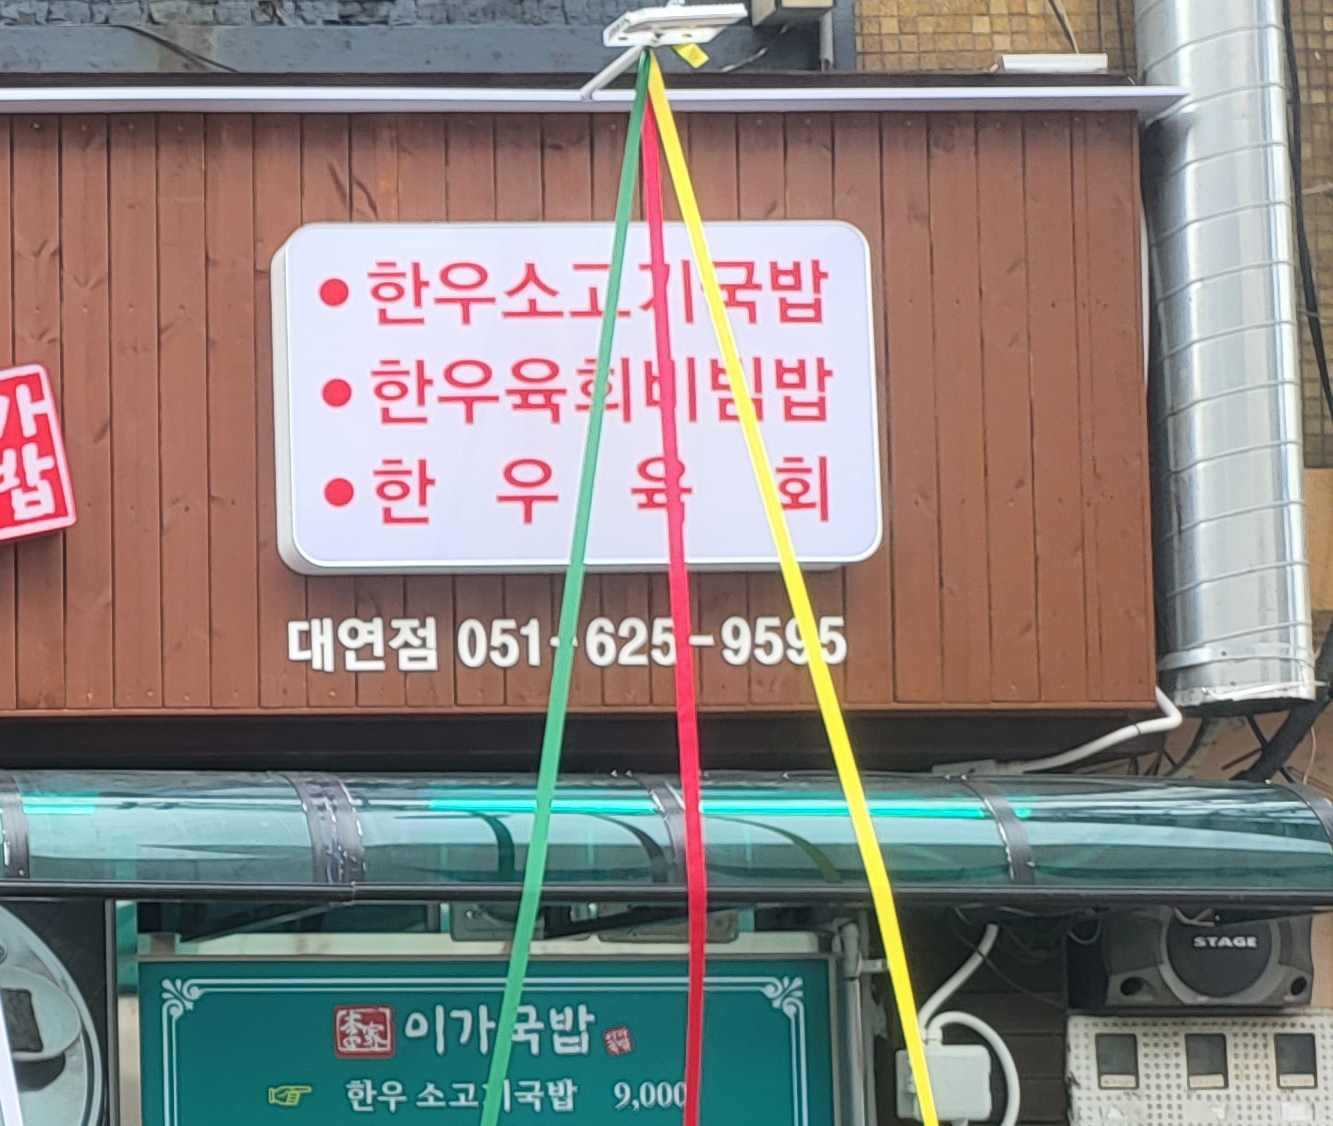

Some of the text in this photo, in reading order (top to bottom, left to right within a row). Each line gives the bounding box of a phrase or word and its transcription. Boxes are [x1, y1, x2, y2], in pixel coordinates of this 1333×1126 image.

[367, 256, 830, 327] 한우소고기국밥
[369, 355, 834, 425] 한우육회비빔밥
[286, 615, 849, 673] 대연점 051-625-9595
[1193, 935, 1258, 948] STAGE
[404, 1003, 596, 1056] 이가국밥
[345, 1078, 408, 1113] 한우
